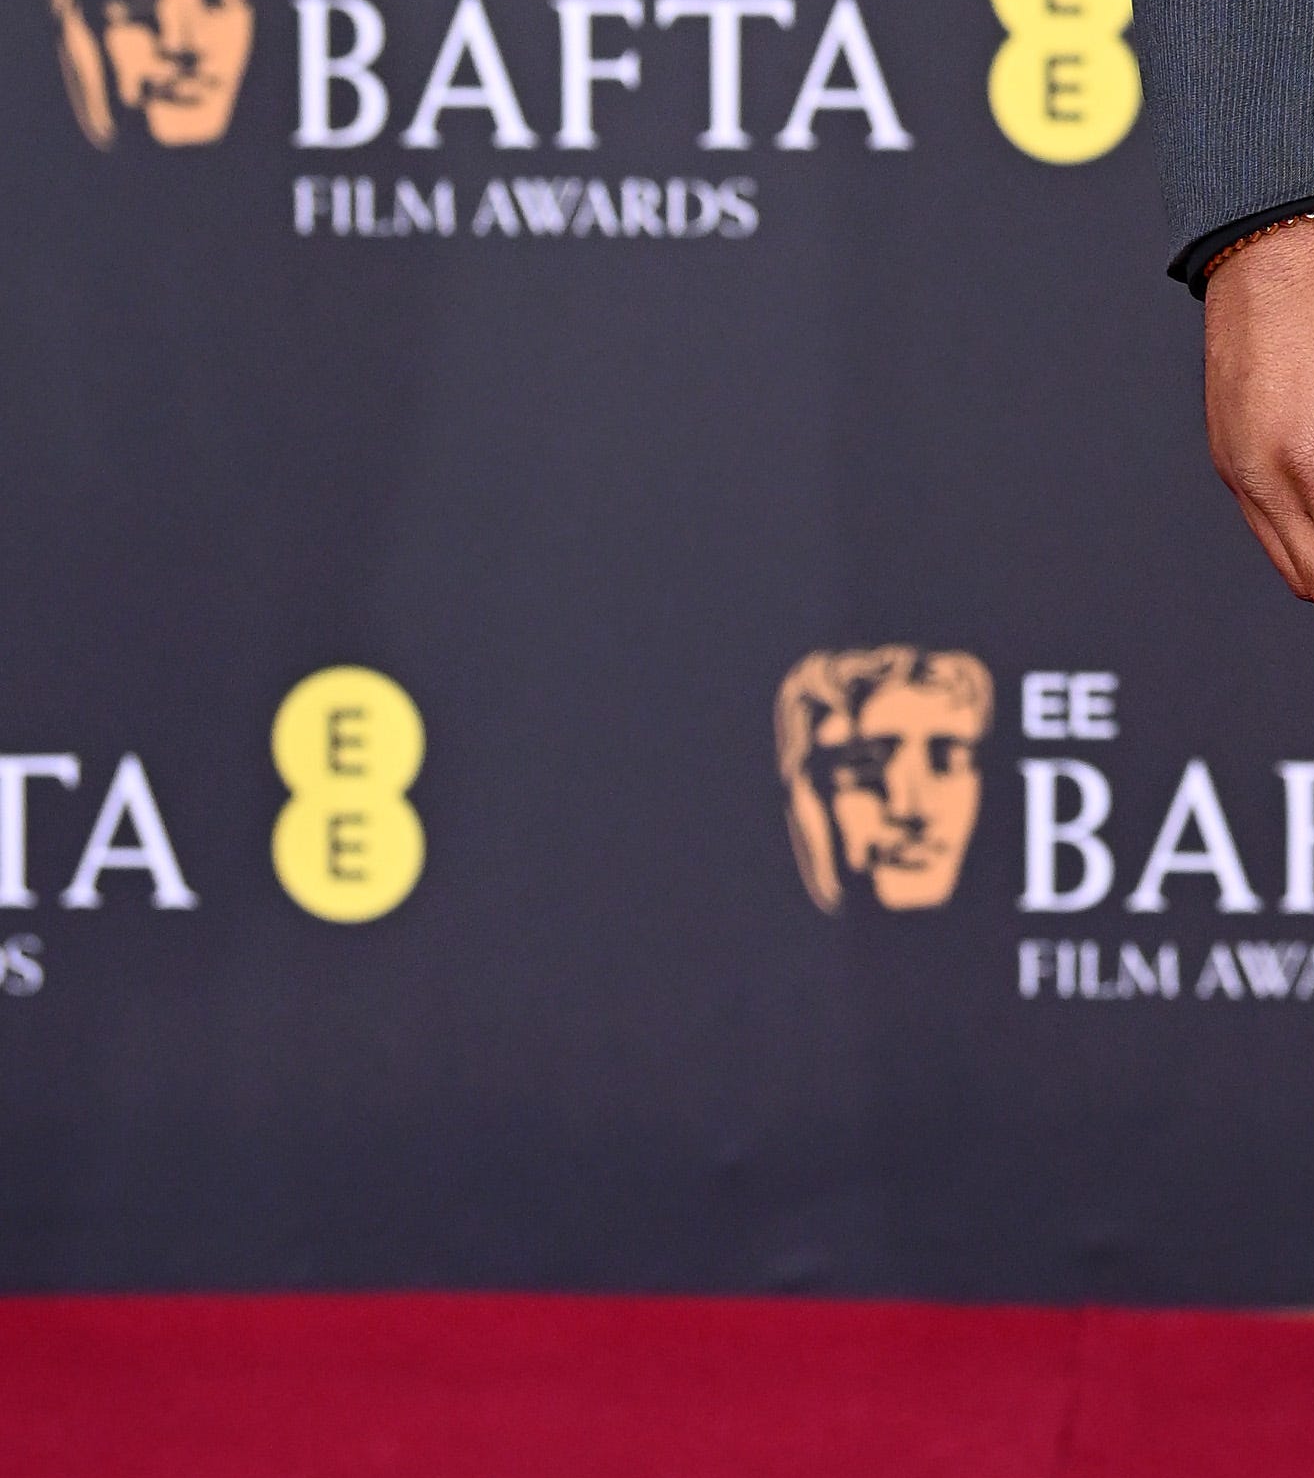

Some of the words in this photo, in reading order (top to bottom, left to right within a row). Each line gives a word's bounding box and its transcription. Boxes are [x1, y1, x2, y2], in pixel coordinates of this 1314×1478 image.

[294, 177, 456, 236] FILM
[473, 177, 758, 237] AWARDS
[1022, 672, 1118, 739] EE
[1019, 941, 1180, 999] FILM
